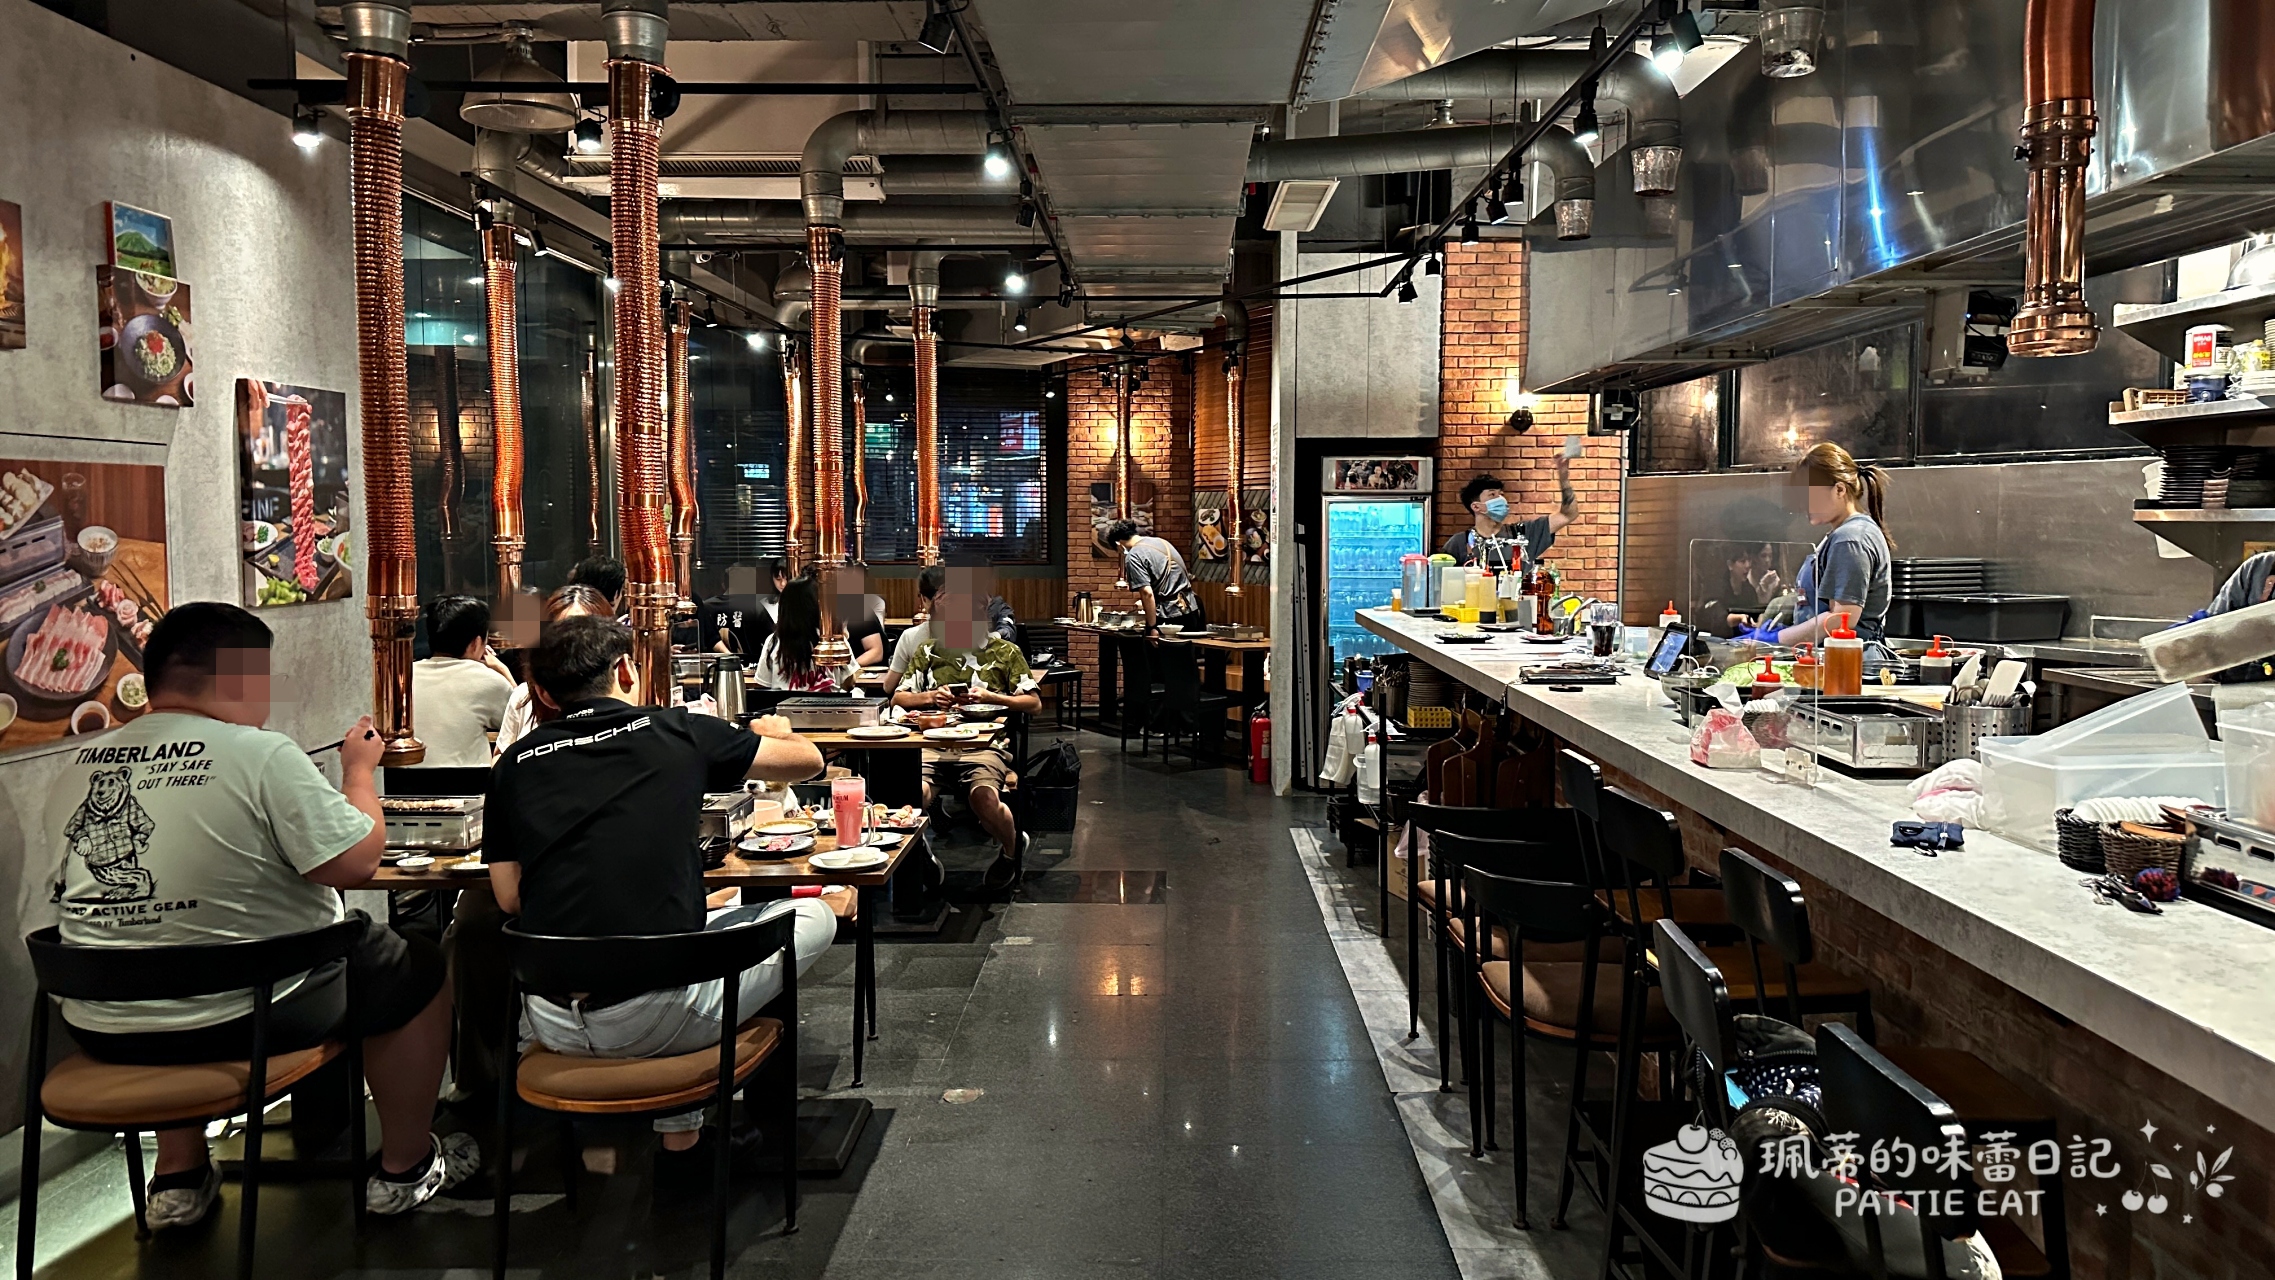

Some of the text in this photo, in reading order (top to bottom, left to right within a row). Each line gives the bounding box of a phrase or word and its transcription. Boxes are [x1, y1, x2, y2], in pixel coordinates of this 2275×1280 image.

[517, 716, 651, 763] PORSCHE
[75, 741, 206, 765] TIMBERLAND
[180, 759, 213, 771] SAFE
[137, 777, 163, 790] OUT
[91, 904, 147, 917] ACTIVE
[153, 900, 198, 912] GEAR
[117, 916, 162, 928] Timberland
